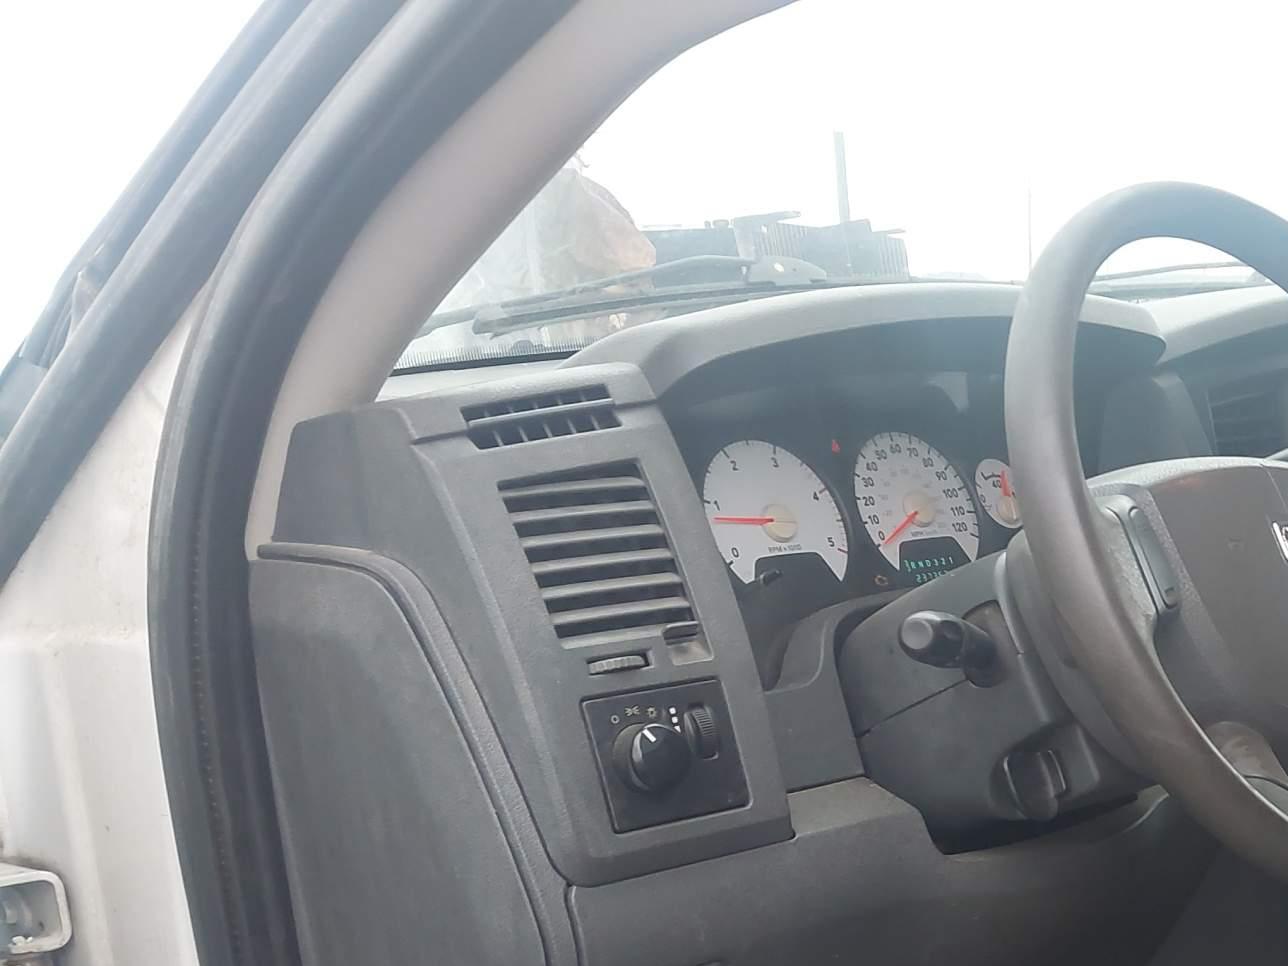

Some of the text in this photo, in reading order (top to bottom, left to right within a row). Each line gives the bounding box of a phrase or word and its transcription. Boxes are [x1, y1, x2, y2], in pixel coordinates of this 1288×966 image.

[889, 443, 902, 454] 60
[907, 447, 919, 457] 70
[874, 449, 887, 461] 50
[730, 460, 739, 471] 2
[771, 457, 779, 468] 3
[866, 461, 878, 472] 40
[922, 457, 934, 468] 80
[935, 470, 948, 481] 90
[861, 477, 874, 488] 30
[813, 491, 820, 501] 4
[942, 487, 959, 499] 100
[713, 500, 721, 512] 1
[862, 495, 875, 507] 20
[950, 506, 966, 516] 110
[868, 514, 880, 525] 10
[951, 521, 968, 533] 120
[877, 531, 884, 541] 0
[827, 537, 835, 548] 5
[731, 547, 740, 558] 0
